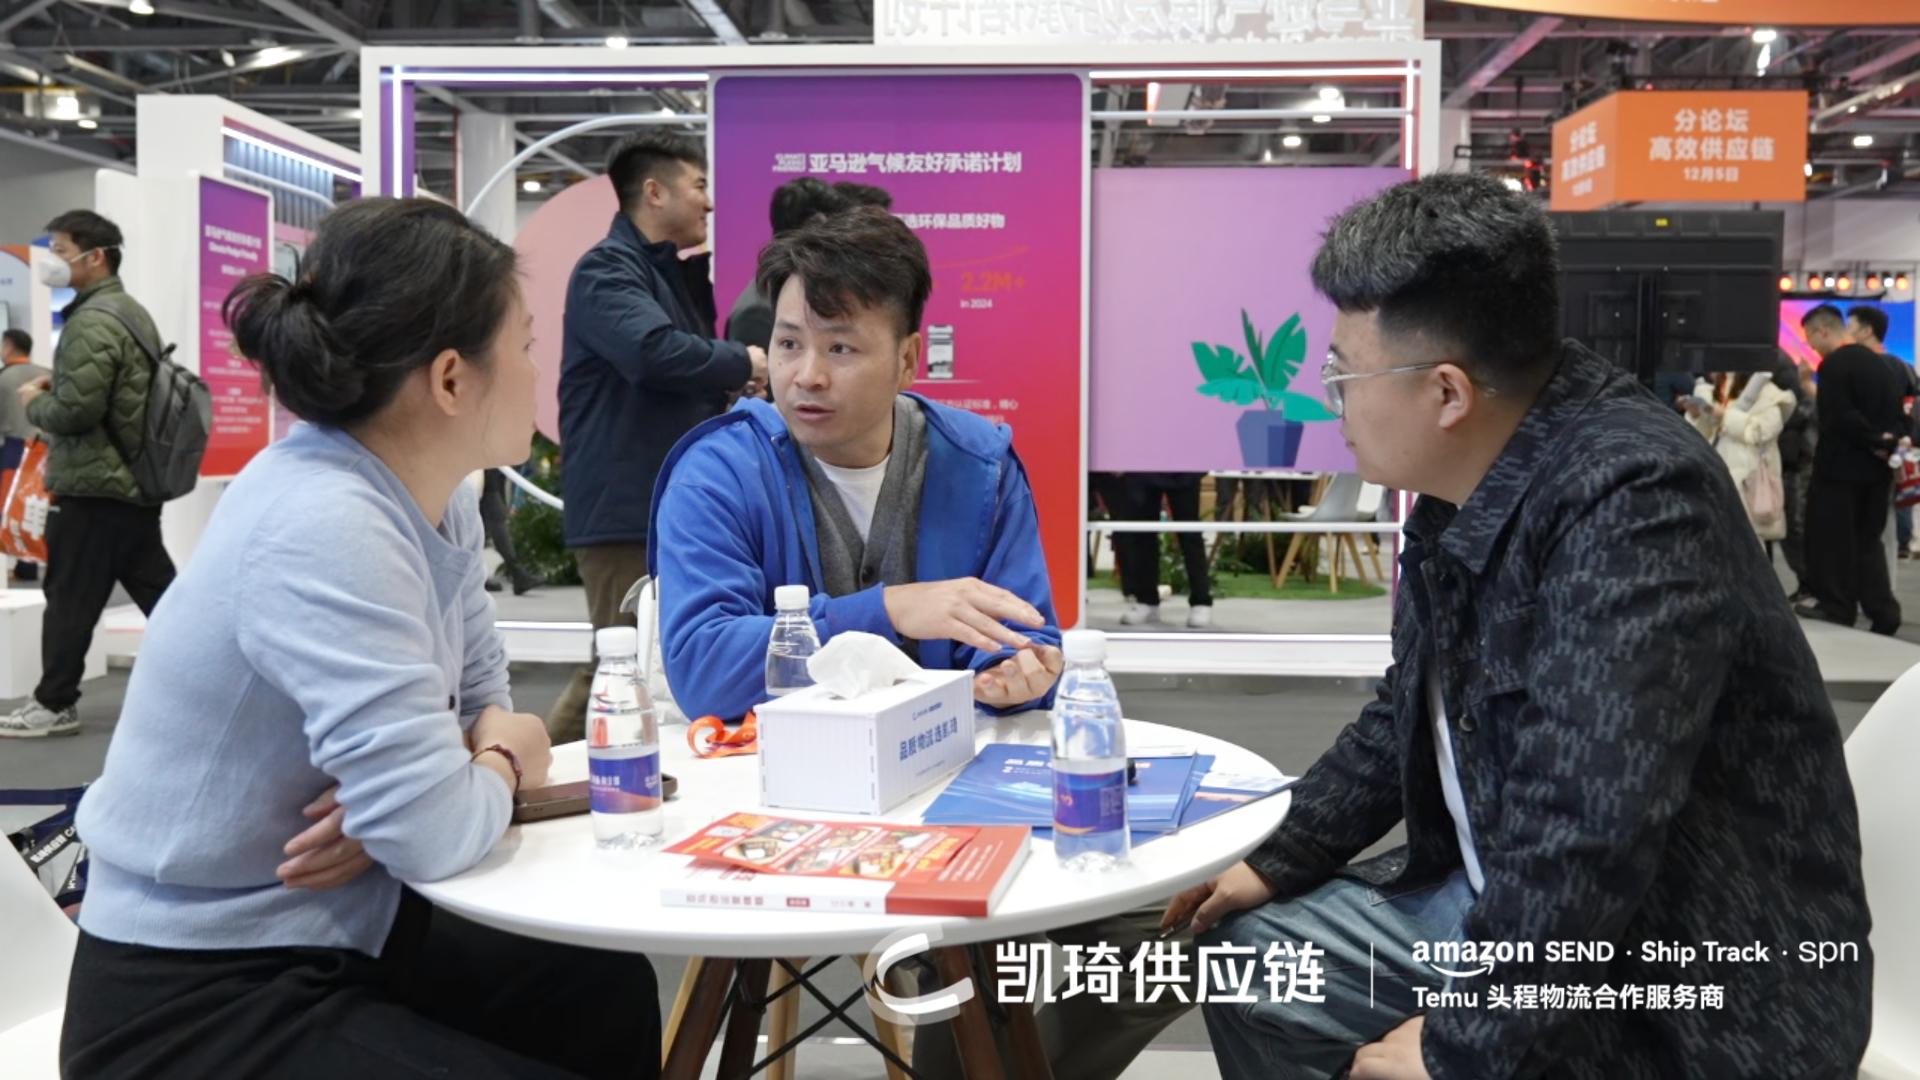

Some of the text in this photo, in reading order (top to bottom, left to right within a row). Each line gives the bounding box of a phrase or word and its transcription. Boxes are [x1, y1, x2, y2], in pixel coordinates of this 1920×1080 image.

[1674, 108, 1749, 132] 分论坛
[1649, 137, 1775, 161] 高效供应链
[809, 153, 1022, 173] 亚马逊气候友好承诺计划
[1683, 167, 1739, 182] 12月5日
